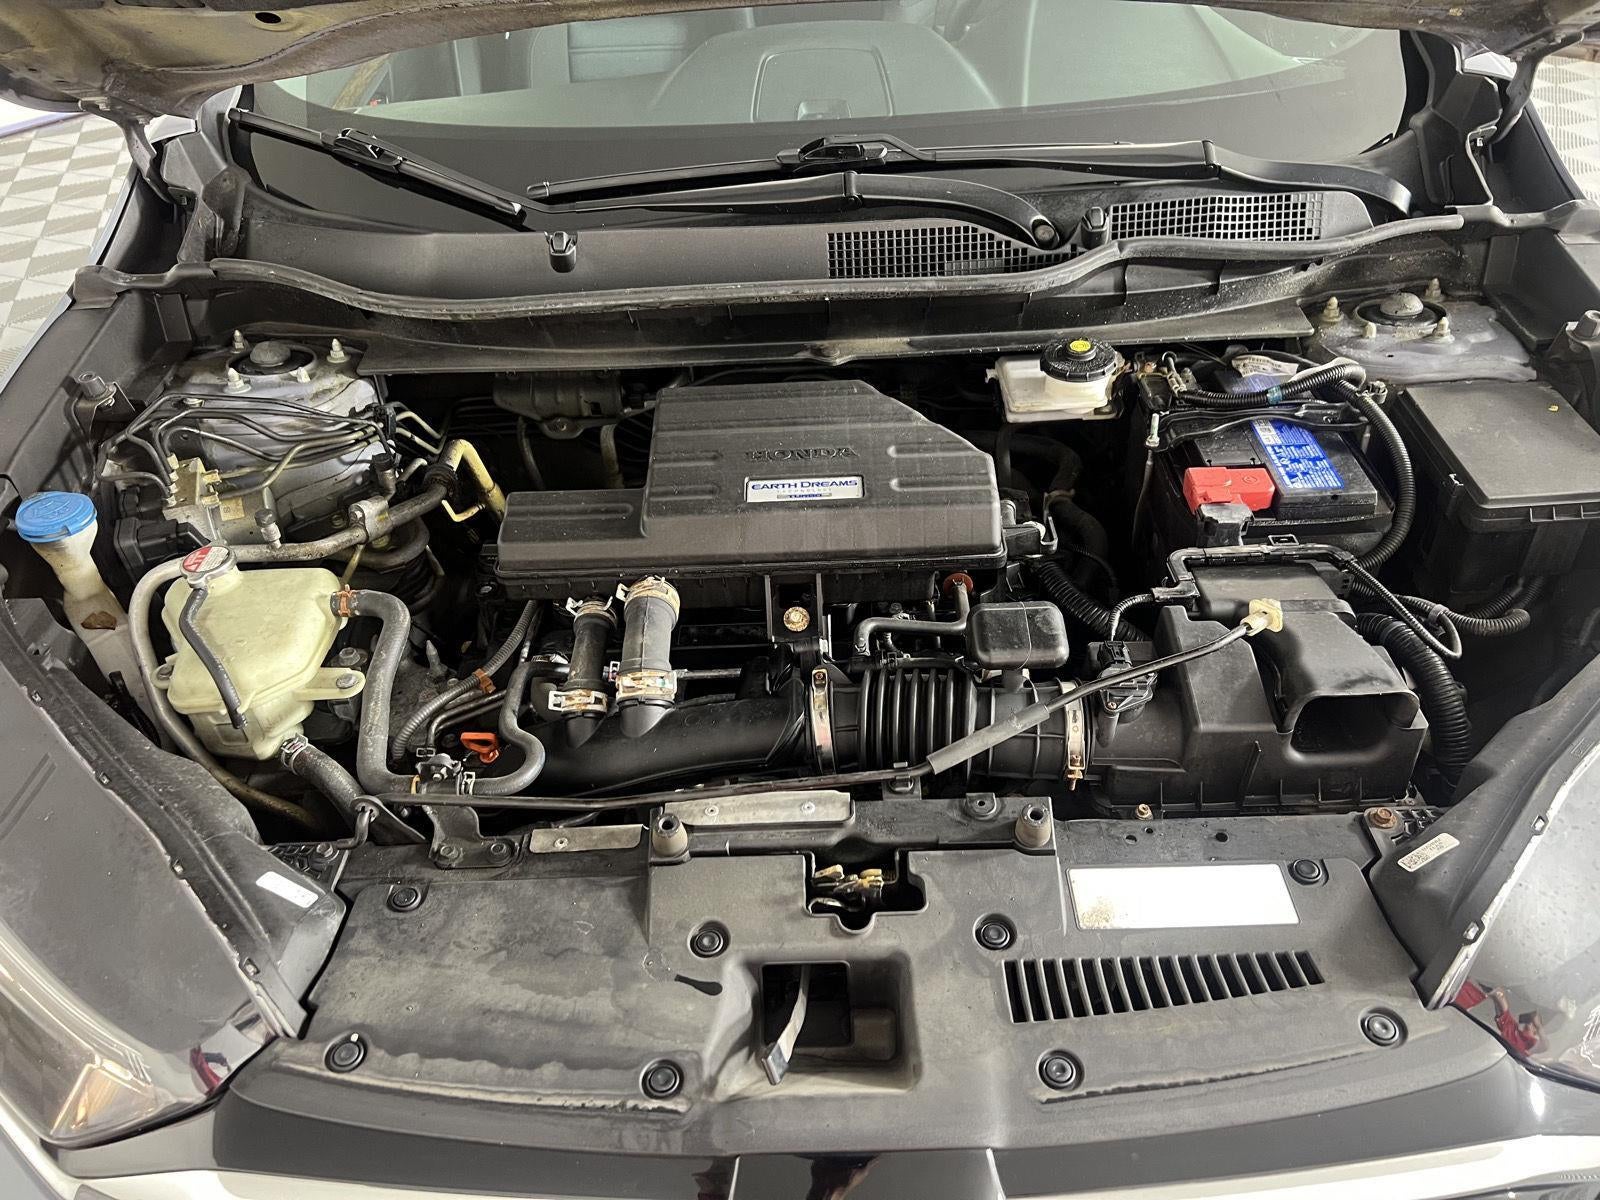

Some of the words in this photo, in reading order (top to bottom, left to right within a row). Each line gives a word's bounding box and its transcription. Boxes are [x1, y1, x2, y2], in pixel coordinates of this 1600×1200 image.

[745, 447, 860, 460] HONDA
[751, 482, 797, 490] EARTH
[800, 480, 858, 488] DREAMS
